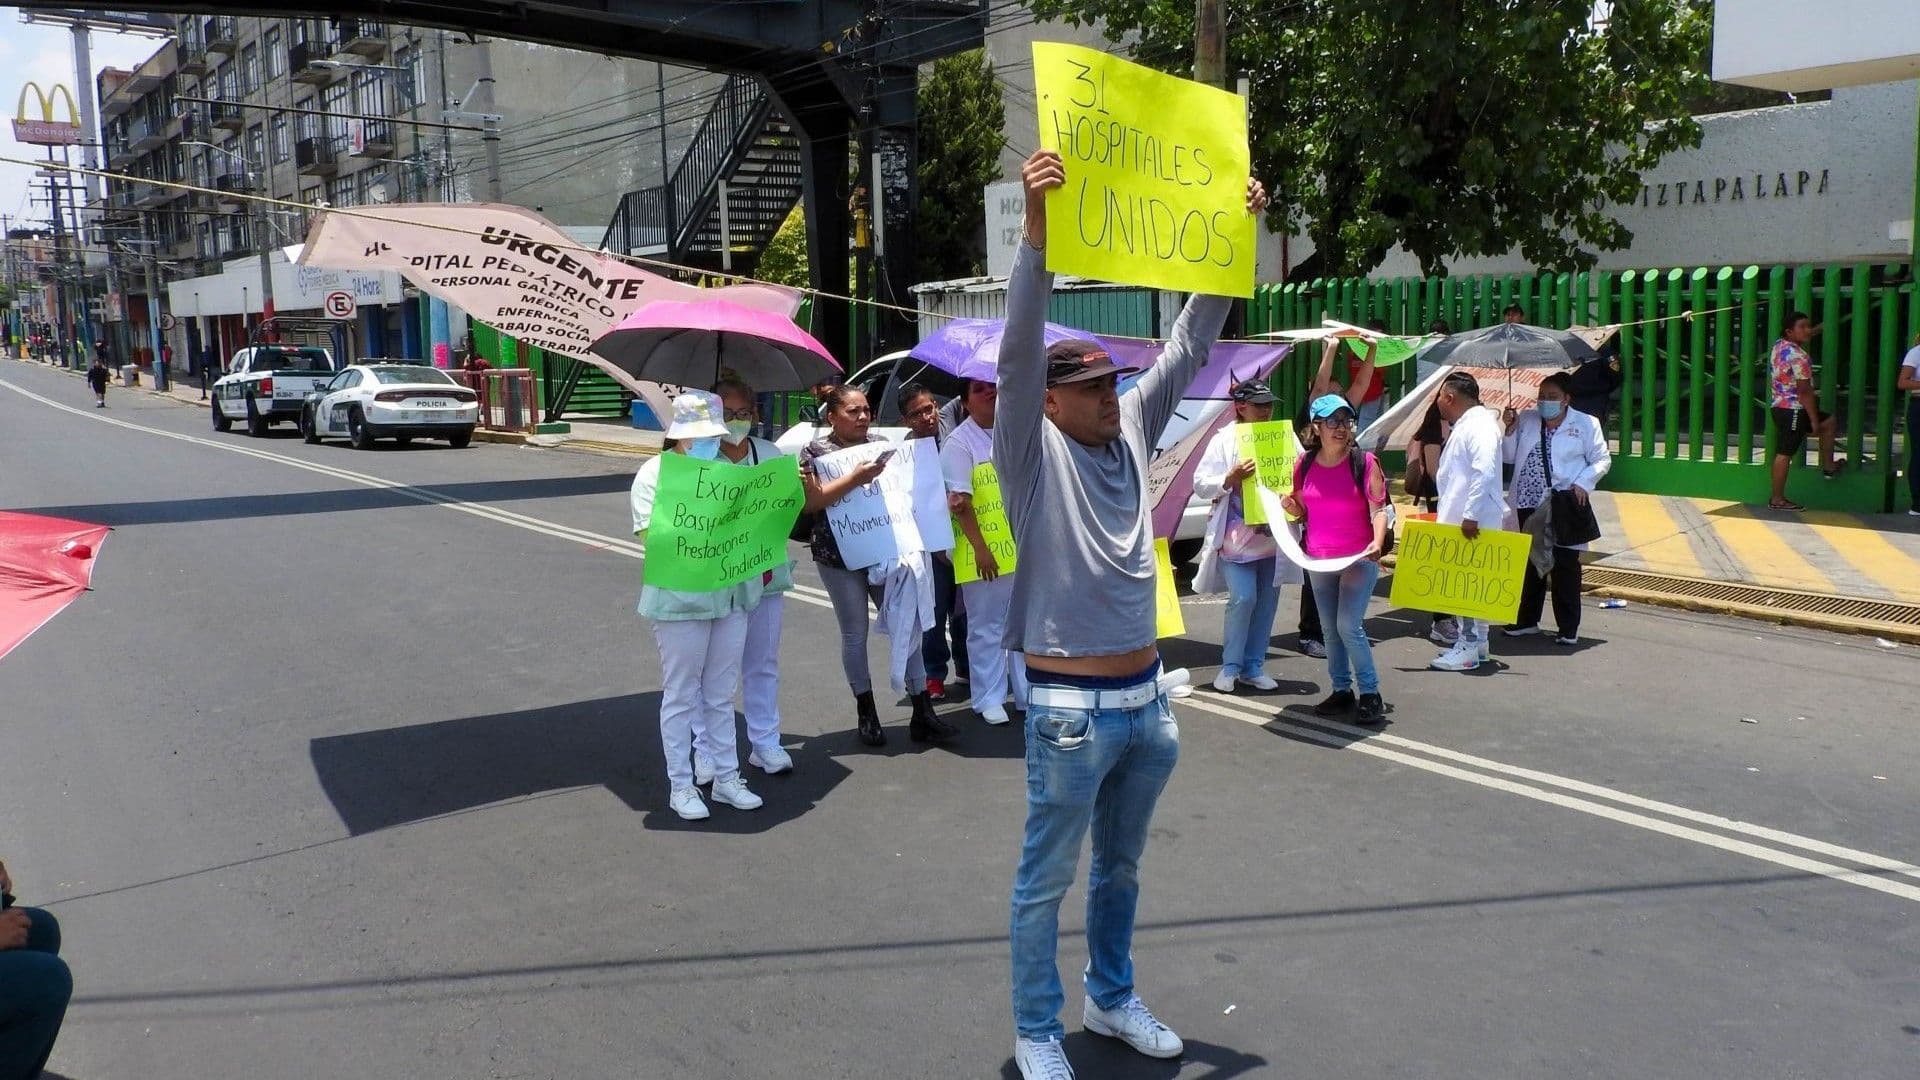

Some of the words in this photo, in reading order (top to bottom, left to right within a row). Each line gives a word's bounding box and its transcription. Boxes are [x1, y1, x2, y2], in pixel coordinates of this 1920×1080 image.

[1067, 59, 1109, 116] 31
[1053, 110, 1213, 187] HOSPITALES
[1642, 168, 1830, 209] IZTAPALAPA
[1078, 177, 1234, 267] UNIDOS
[364, 240, 474, 271] HPITAL
[482, 255, 615, 318] PEDIÁTRICO
[480, 226, 645, 300] URGENTE
[496, 306, 590, 335] ENFERMERÍA
[520, 294, 580, 319] MÉDICA
[479, 318, 542, 334] RABAJO
[545, 325, 596, 344] SOCIA
[519, 336, 591, 356] OTERAPIA
[416, 400, 447, 408] POLICIA
[695, 466, 777, 507] Exigimos
[771, 498, 796, 510] con
[677, 531, 750, 560] Prestaciones
[719, 543, 773, 582] Sindicales
[1403, 529, 1511, 573] HOMOLOGAR
[1409, 565, 1517, 608] SALARIOS
